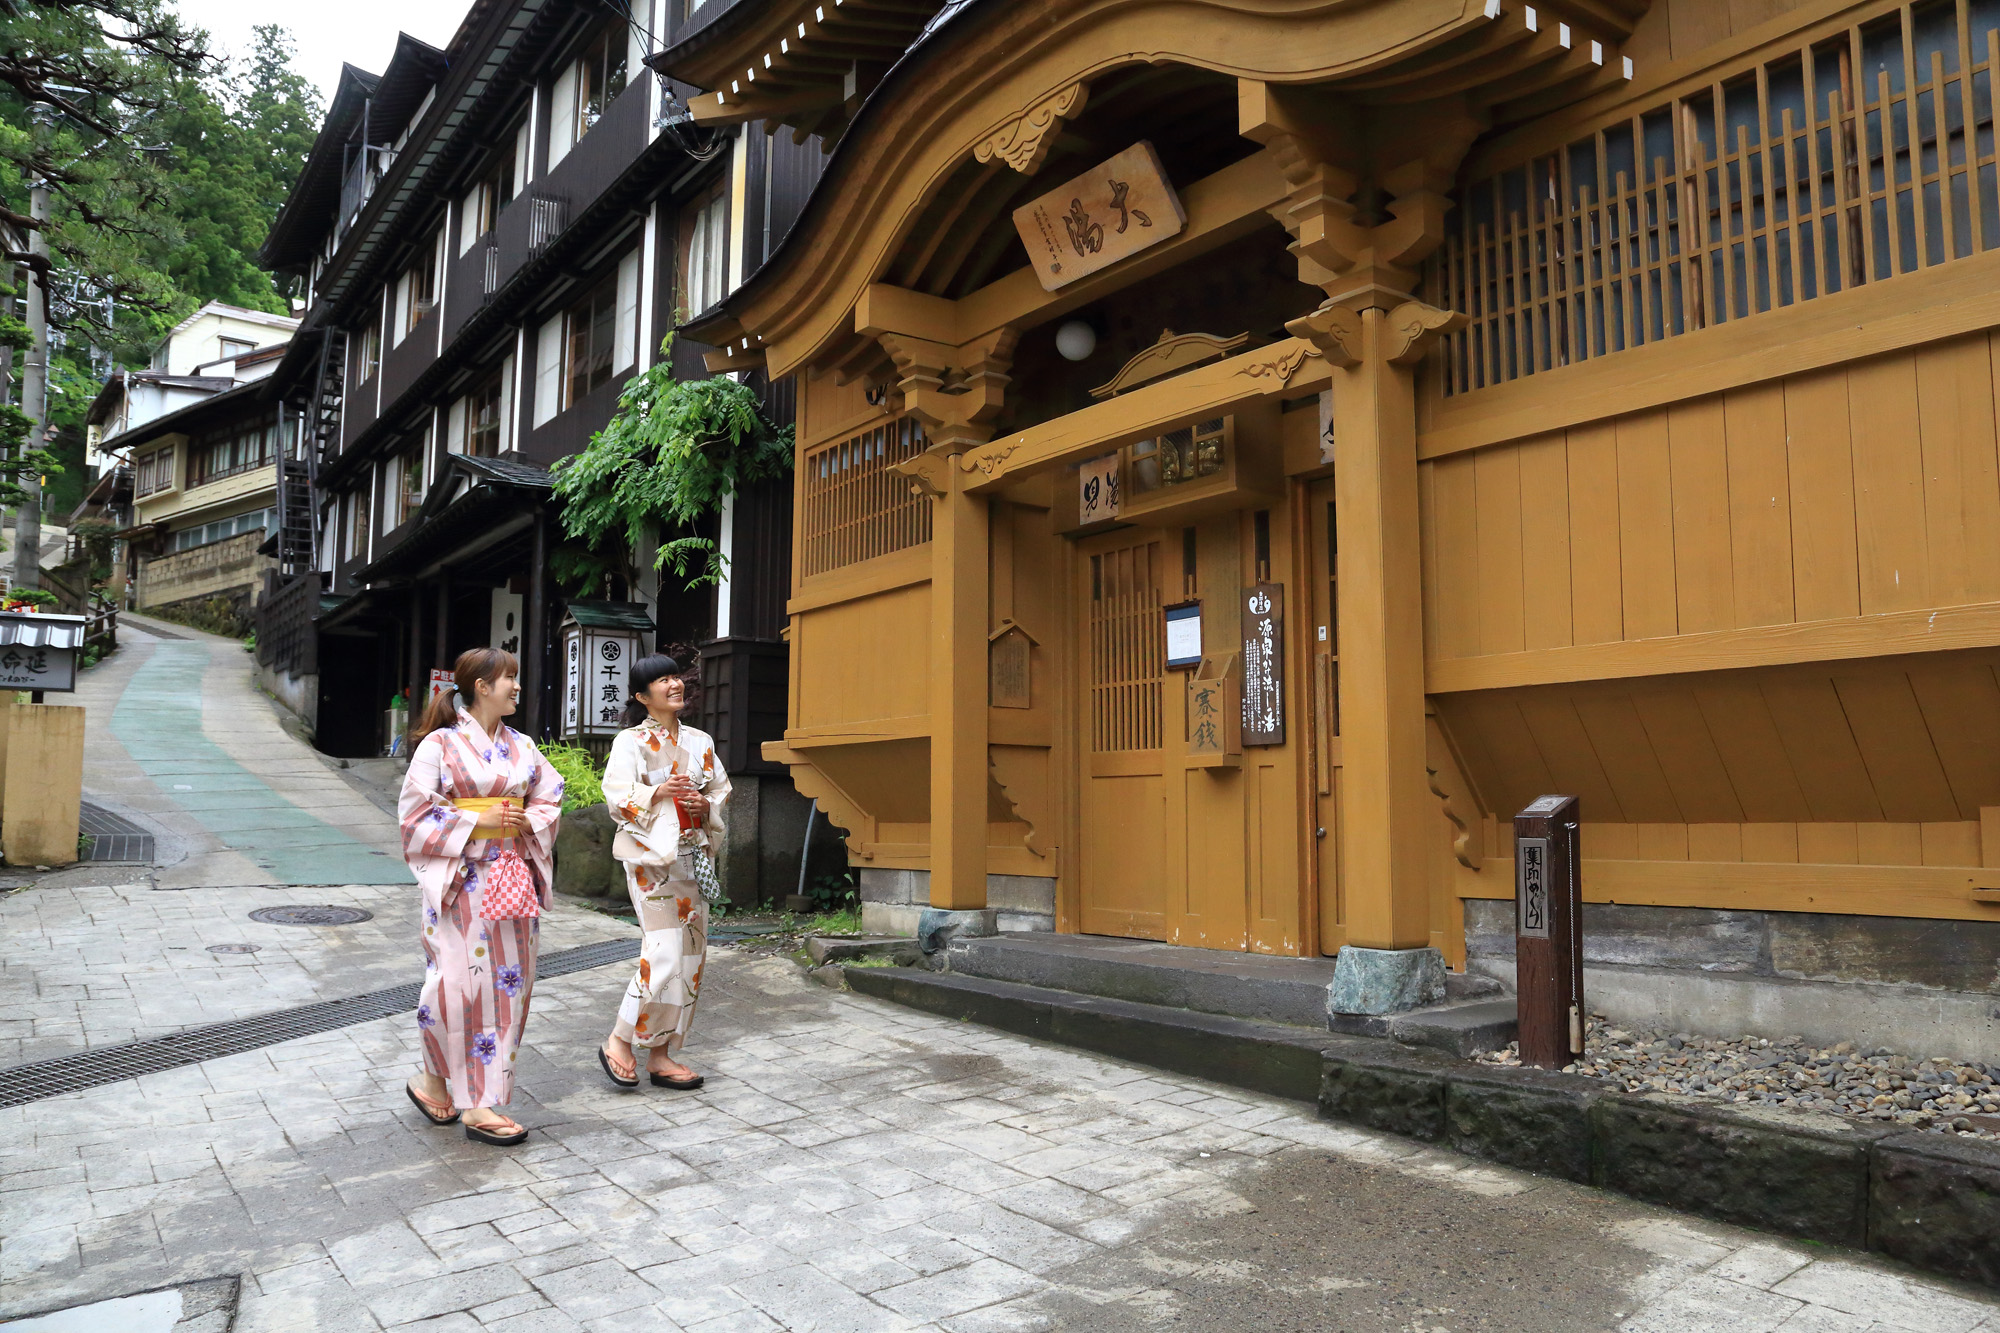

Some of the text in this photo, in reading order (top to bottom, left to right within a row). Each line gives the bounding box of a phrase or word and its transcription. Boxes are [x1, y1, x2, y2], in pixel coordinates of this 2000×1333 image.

[0, 649, 48, 674] 命延
[600, 665, 621, 723] 千歳館
[1526, 848, 1541, 927] 集印めぐり
